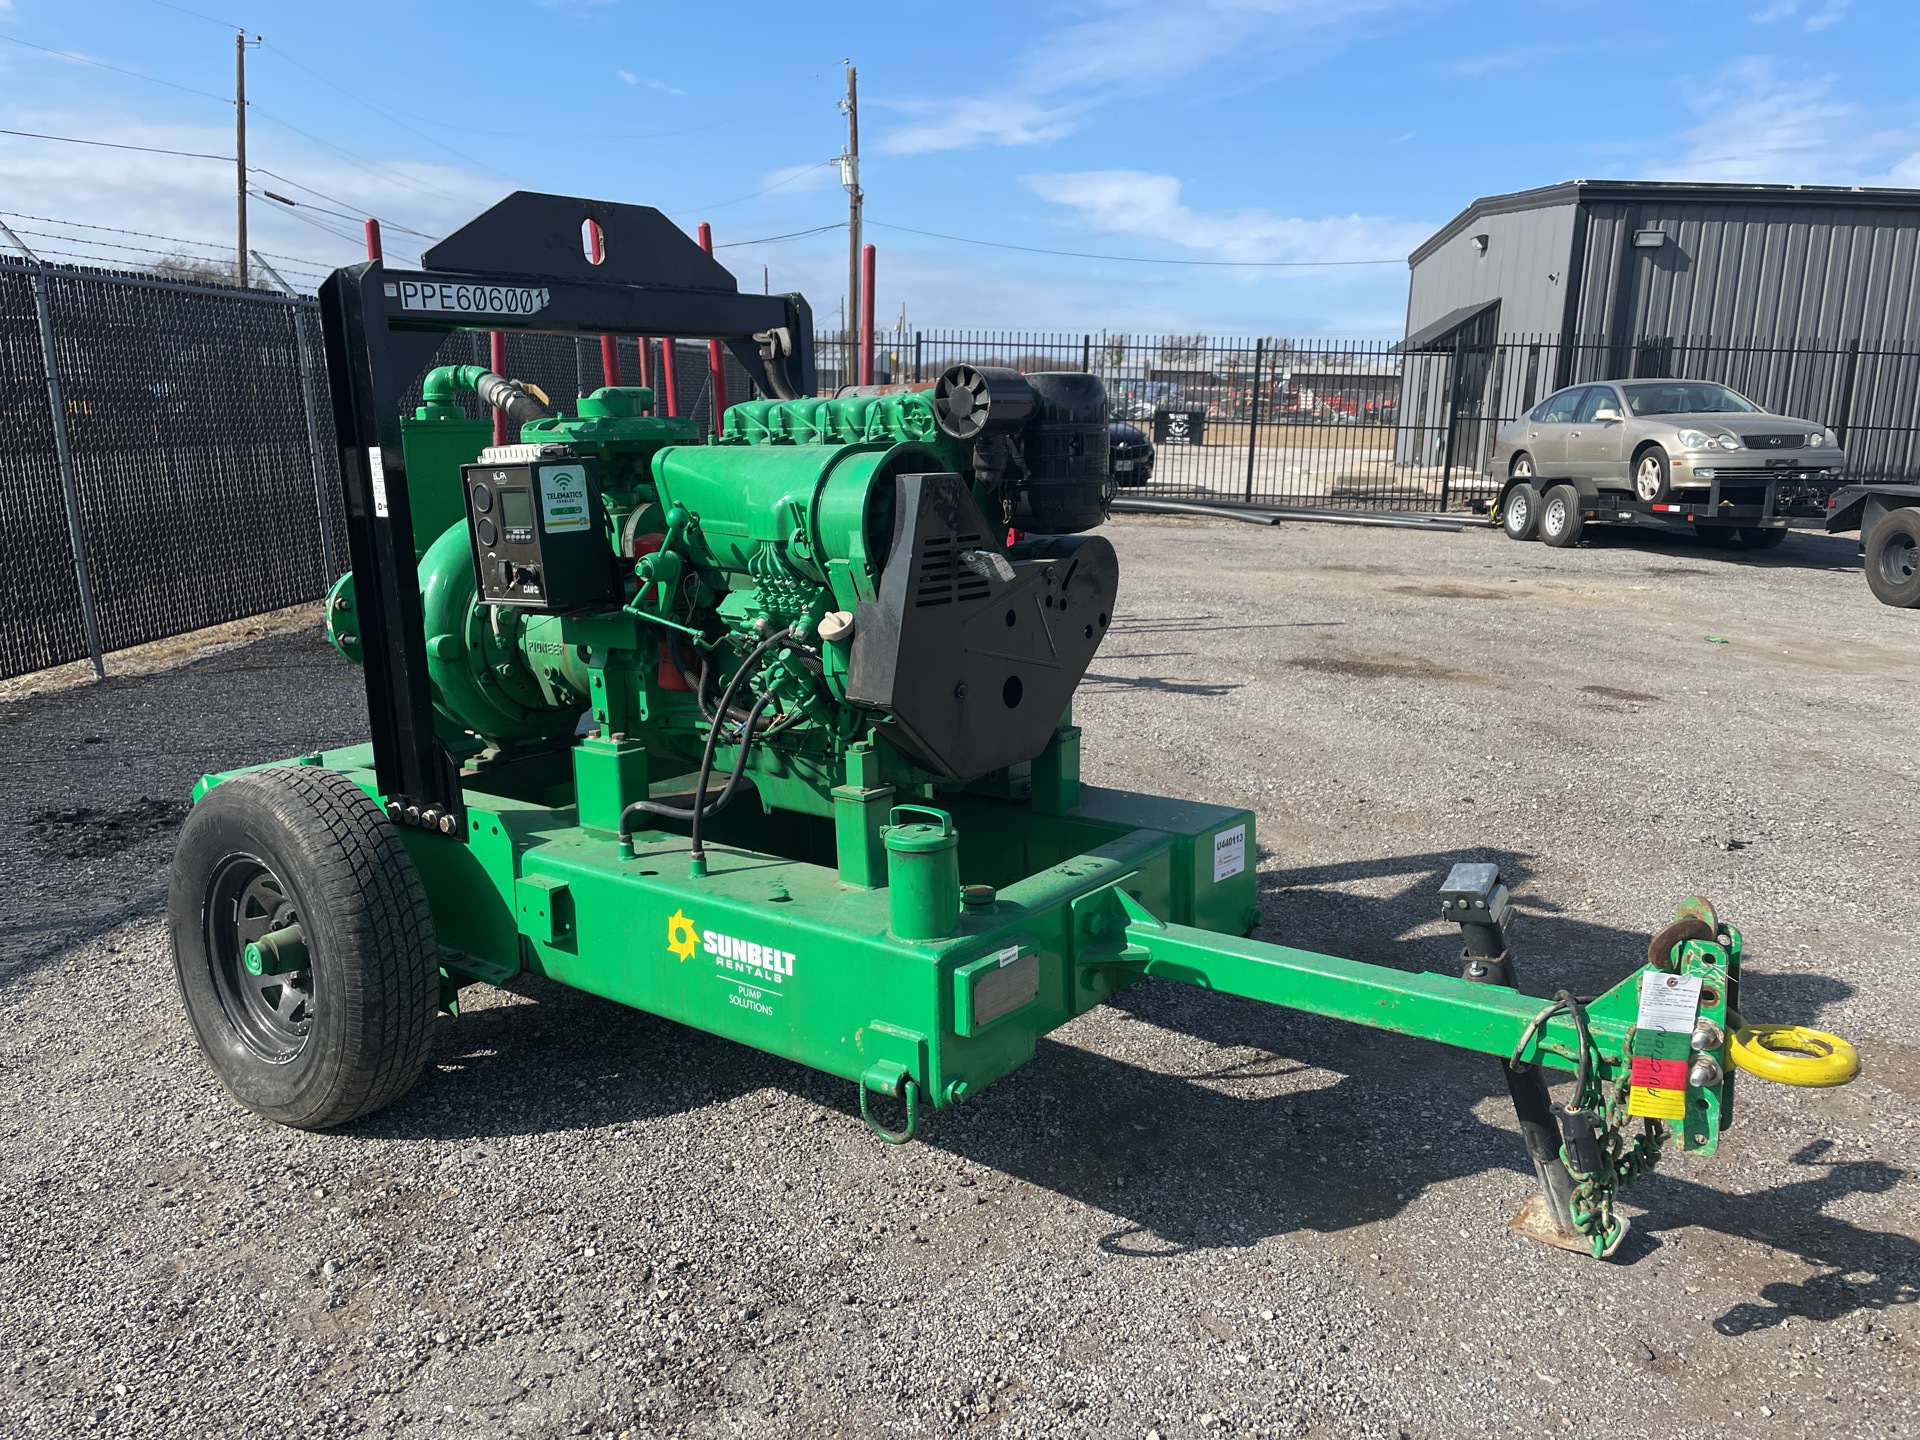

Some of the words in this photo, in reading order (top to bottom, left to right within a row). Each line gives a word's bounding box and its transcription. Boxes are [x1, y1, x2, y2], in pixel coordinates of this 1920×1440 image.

[402, 283, 546, 313] PPE606001
[546, 491, 583, 500] TELEMATICS
[528, 641, 564, 656] PIONEER
[1217, 833, 1244, 851] U440113
[703, 930, 796, 976] SUNBELT
[715, 956, 783, 984] RENTALS
[738, 985, 761, 1000] PUMP
[729, 994, 773, 1016] SOLUTIONS
[1646, 1025, 1667, 1098] AUCTION
